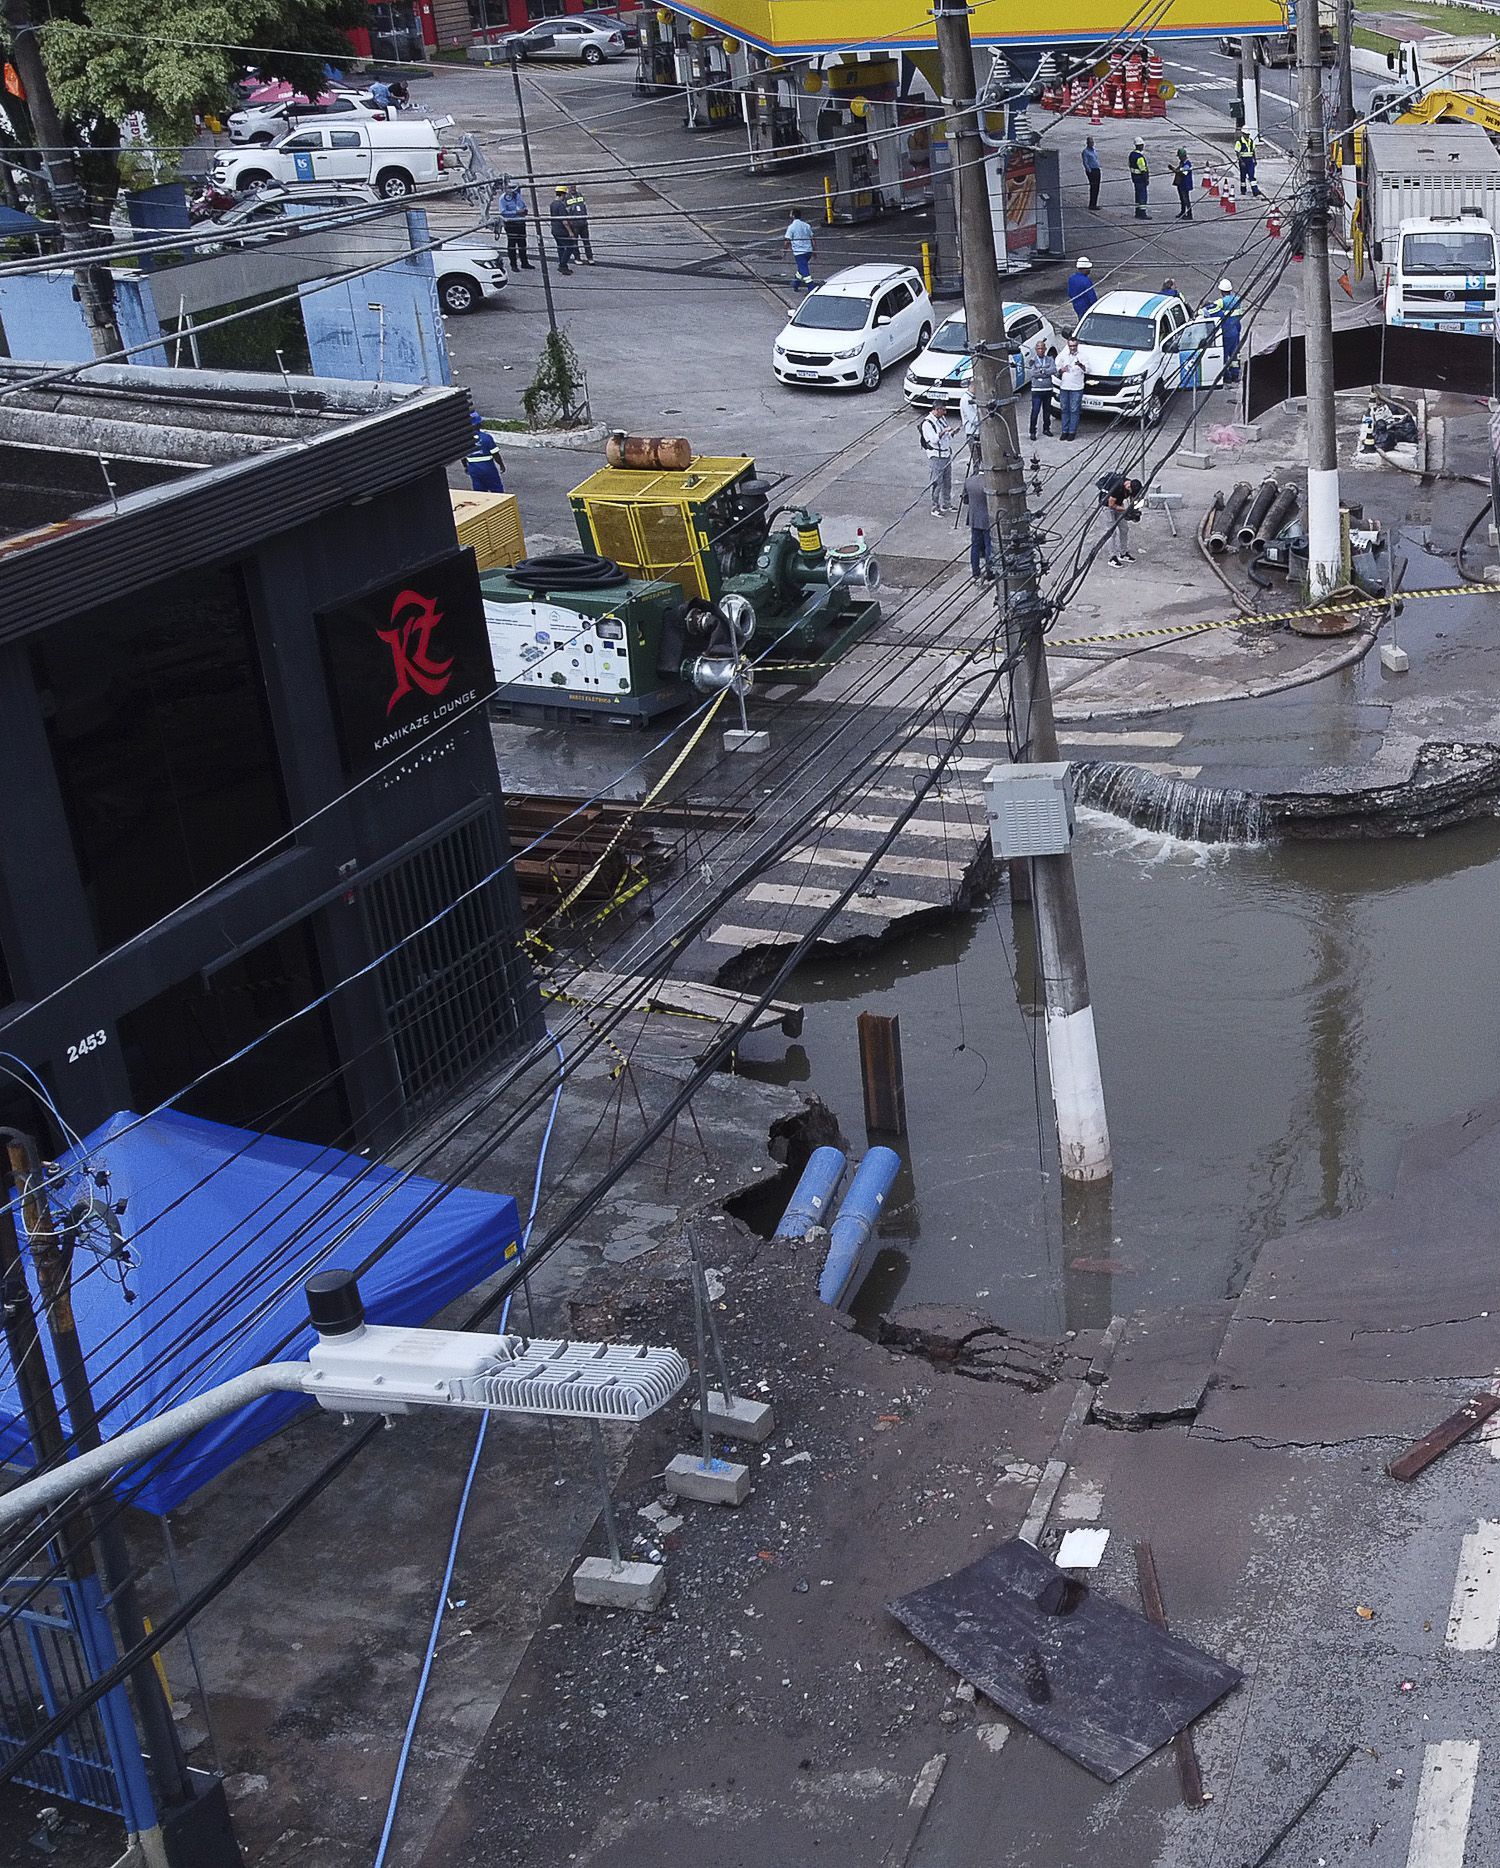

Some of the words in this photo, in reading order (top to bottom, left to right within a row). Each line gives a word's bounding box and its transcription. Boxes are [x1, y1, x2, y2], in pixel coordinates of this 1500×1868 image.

[1485, 115, 1500, 127] NEW
[374, 714, 430, 751] KAMIKAZE
[433, 689, 478, 721] LOUNGE
[67, 1029, 107, 1063] 2453
